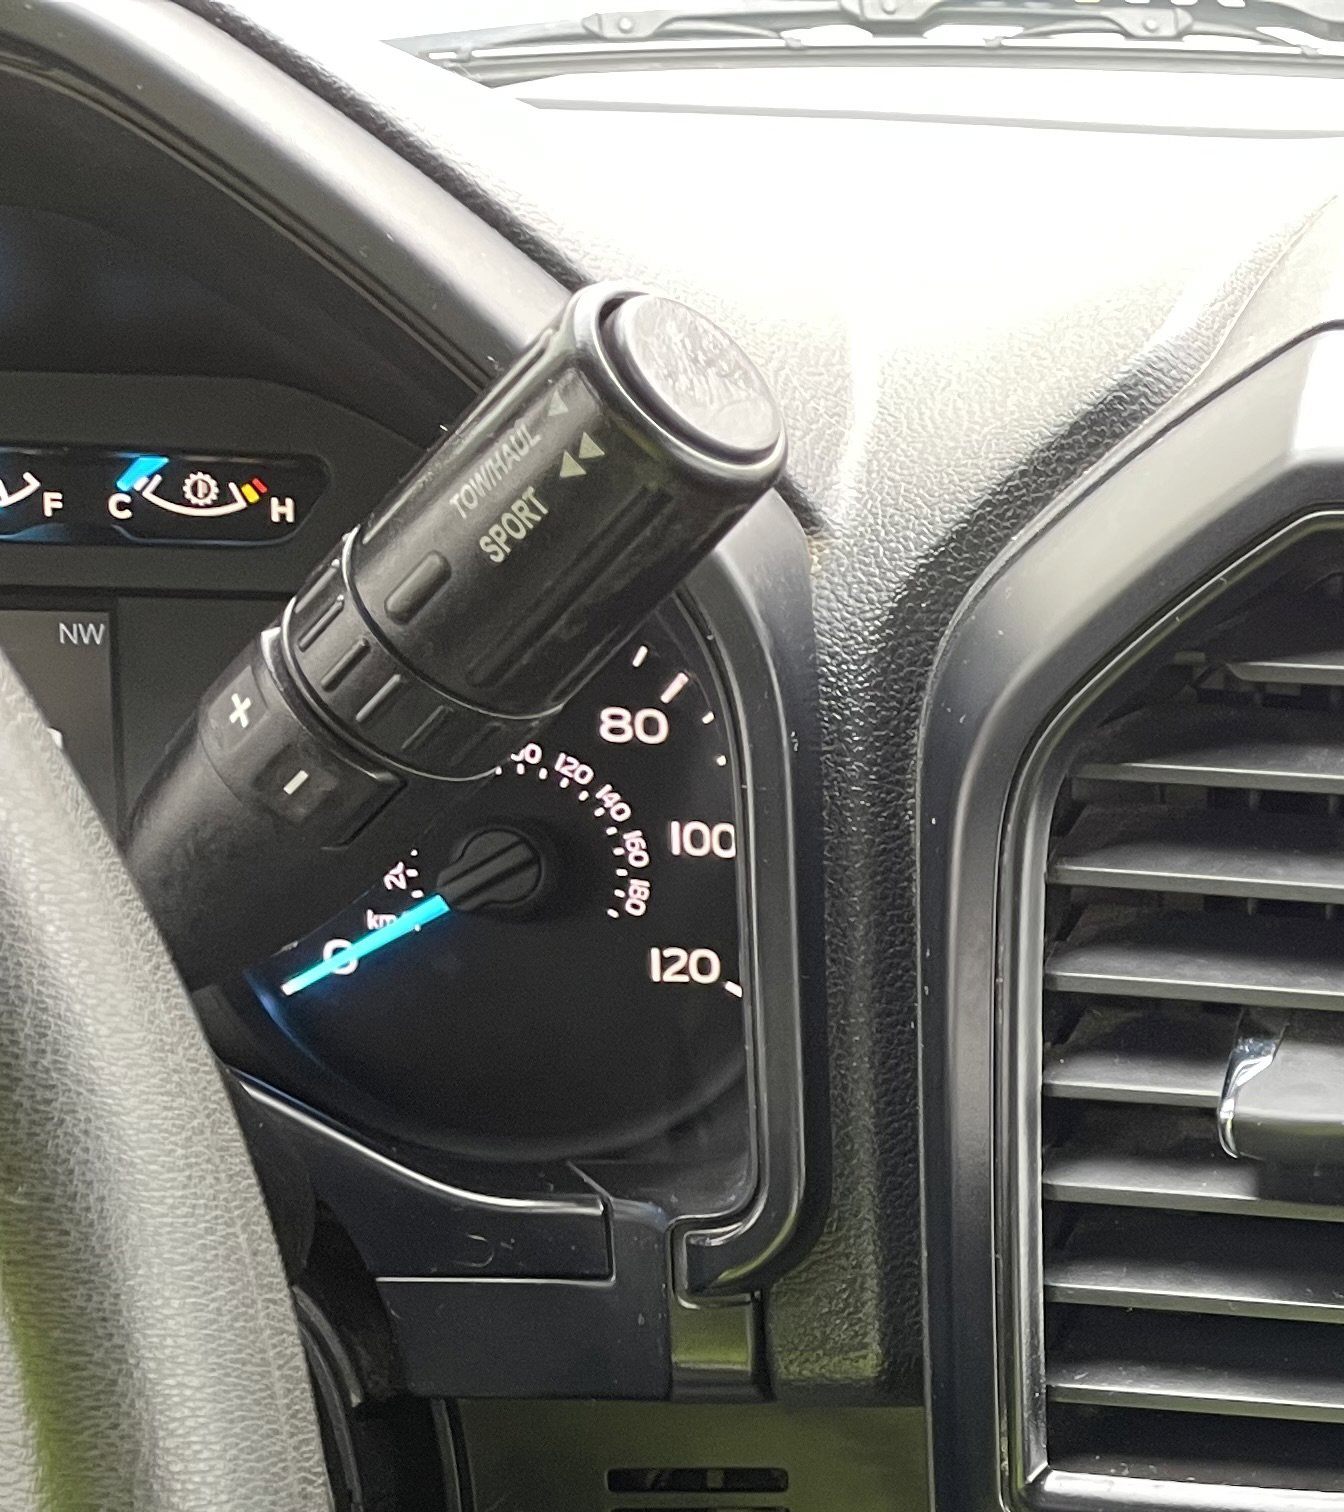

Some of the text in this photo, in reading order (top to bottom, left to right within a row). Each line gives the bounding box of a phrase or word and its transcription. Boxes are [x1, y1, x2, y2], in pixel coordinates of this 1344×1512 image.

[42, 491, 63, 517] F
[108, 492, 133, 520] C
[270, 496, 295, 523] H
[479, 486, 549, 563] SPORT
[58, 622, 105, 645] NW
[599, 706, 669, 745] 80
[554, 752, 595, 785] 120
[595, 783, 632, 823] 140
[622, 829, 650, 869] 160
[668, 819, 737, 860] 100
[624, 877, 651, 917] 180
[650, 947, 721, 984] 120
